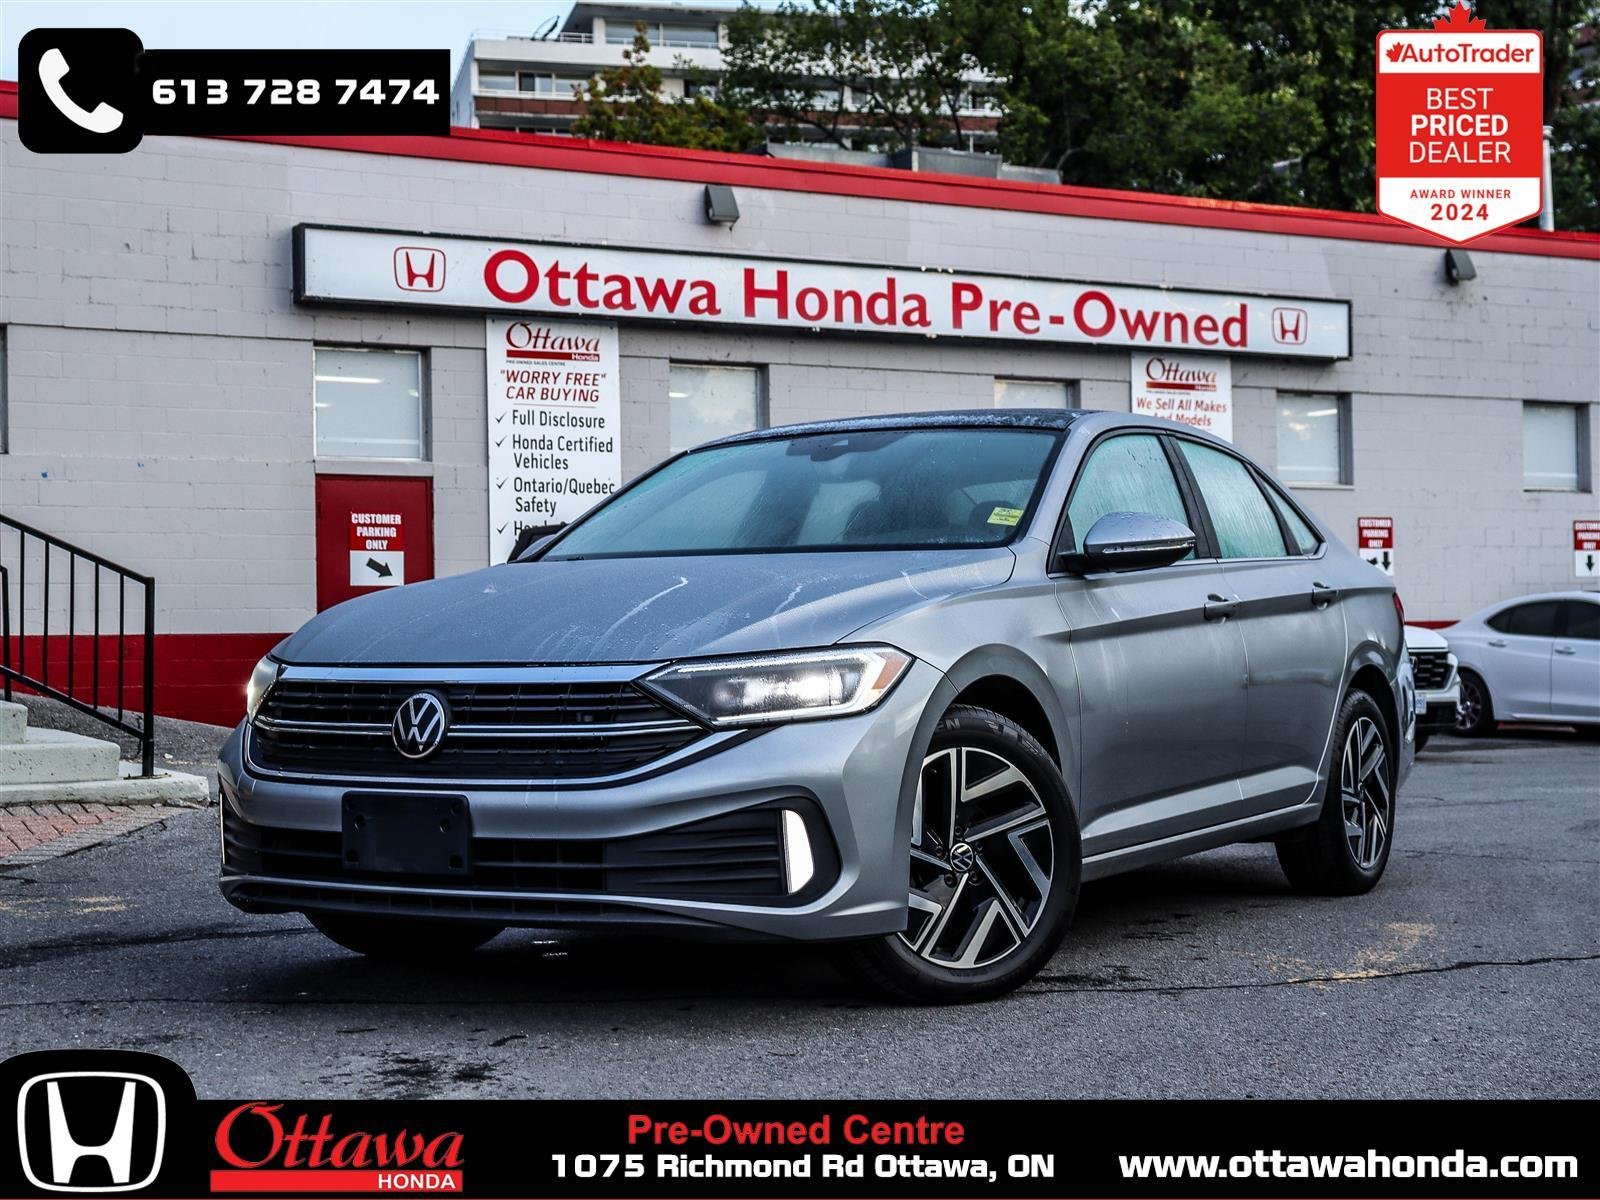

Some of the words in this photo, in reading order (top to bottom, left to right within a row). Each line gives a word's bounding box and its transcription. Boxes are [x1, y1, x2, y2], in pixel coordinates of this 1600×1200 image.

[483, 249, 722, 317] Ottawa
[743, 267, 932, 328] Honda
[950, 281, 1249, 348] Pre-Owned
[505, 321, 600, 352] Ottawa
[571, 353, 599, 362] Honda
[1146, 356, 1217, 383] Ottawa
[506, 386, 536, 400] CAR
[540, 387, 599, 402] BUYING
[1136, 397, 1152, 409] We
[1155, 398, 1175, 410] Sell
[1177, 399, 1192, 411] All
[1194, 400, 1228, 413] Makes
[512, 409, 535, 426] Full
[540, 411, 605, 428] Disclosure
[512, 434, 553, 450] Honda
[557, 435, 613, 453] Certified
[514, 453, 568, 470] Vehicles
[514, 477, 615, 495] Ontario/Quebec
[515, 496, 556, 517] Safety
[351, 513, 401, 525] CUSTOMER
[1359, 519, 1392, 528] CUSTOMER
[356, 526, 397, 537] PARKING
[1362, 529, 1389, 538] PARKING
[366, 540, 388, 550] ONLY
